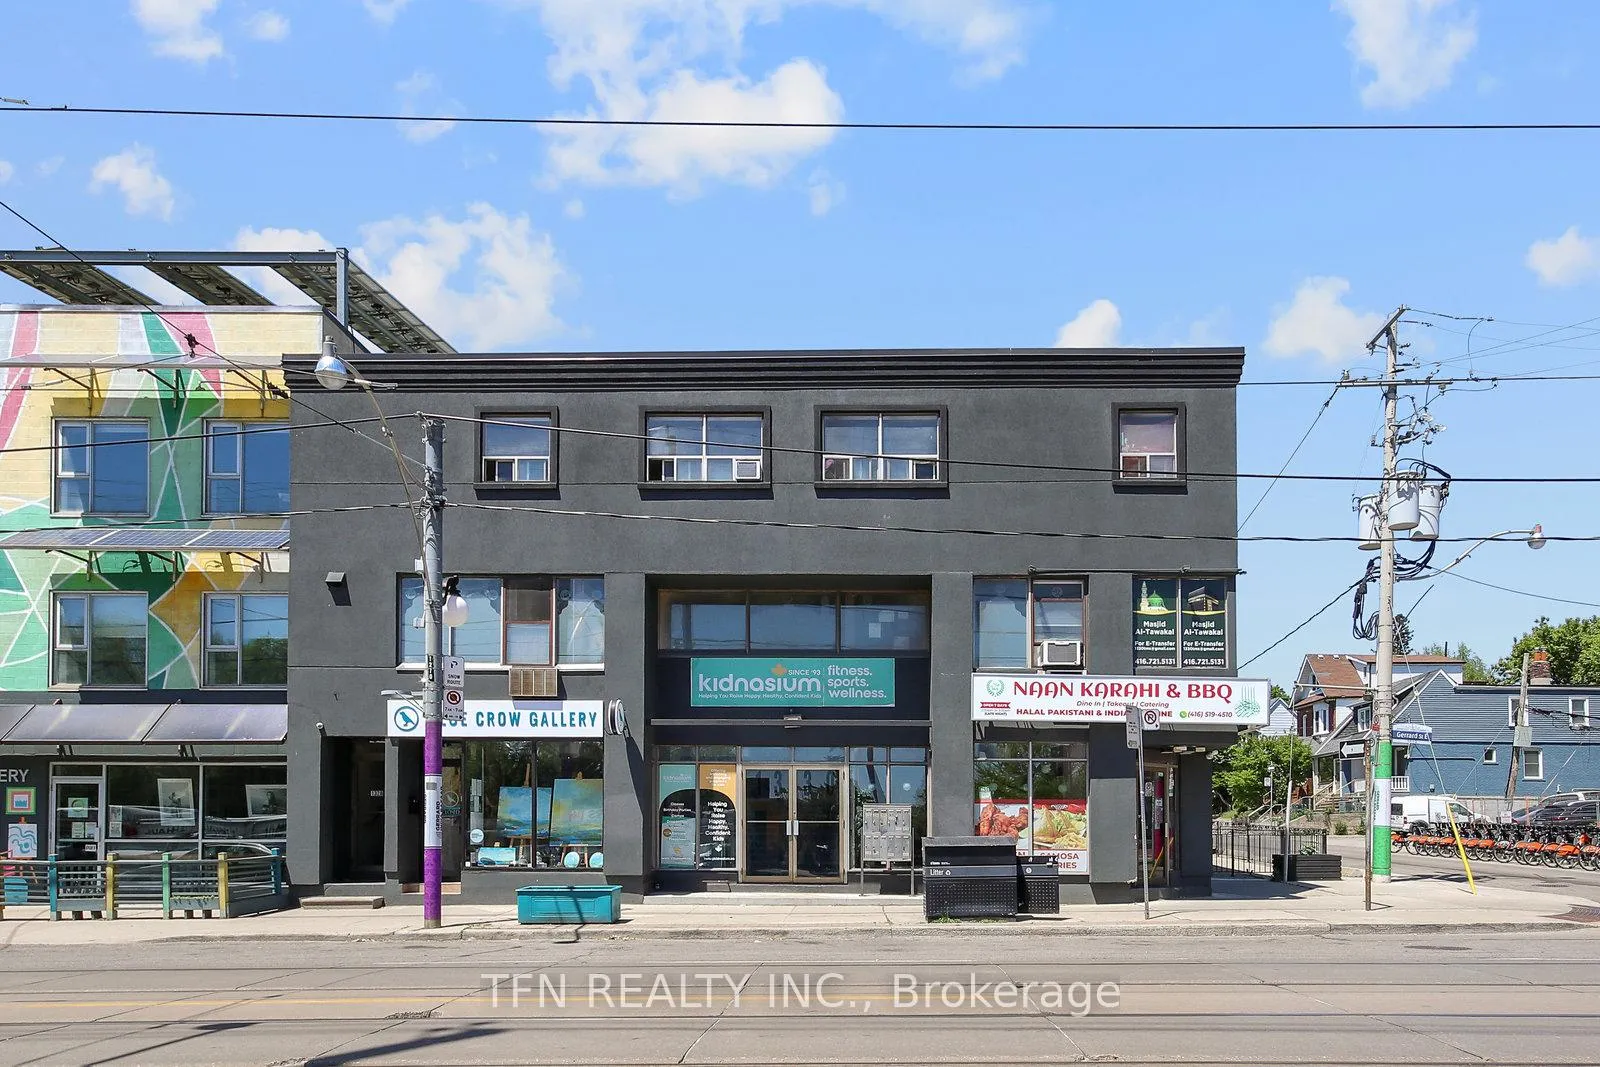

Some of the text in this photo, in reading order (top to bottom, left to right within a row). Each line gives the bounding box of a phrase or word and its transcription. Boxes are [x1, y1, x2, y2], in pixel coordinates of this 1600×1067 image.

[827, 665, 872, 676] fitness.
[699, 674, 821, 692] kidnasium
[827, 676, 869, 688] sports.
[828, 688, 887, 698] wellness.
[1014, 681, 1074, 698] NAAN
[1080, 682, 1159, 699] KARAHI
[1166, 683, 1181, 698] &
[1188, 684, 1232, 703] BBQ
[476, 712, 521, 727] CROW
[530, 712, 597, 727] GALLERY
